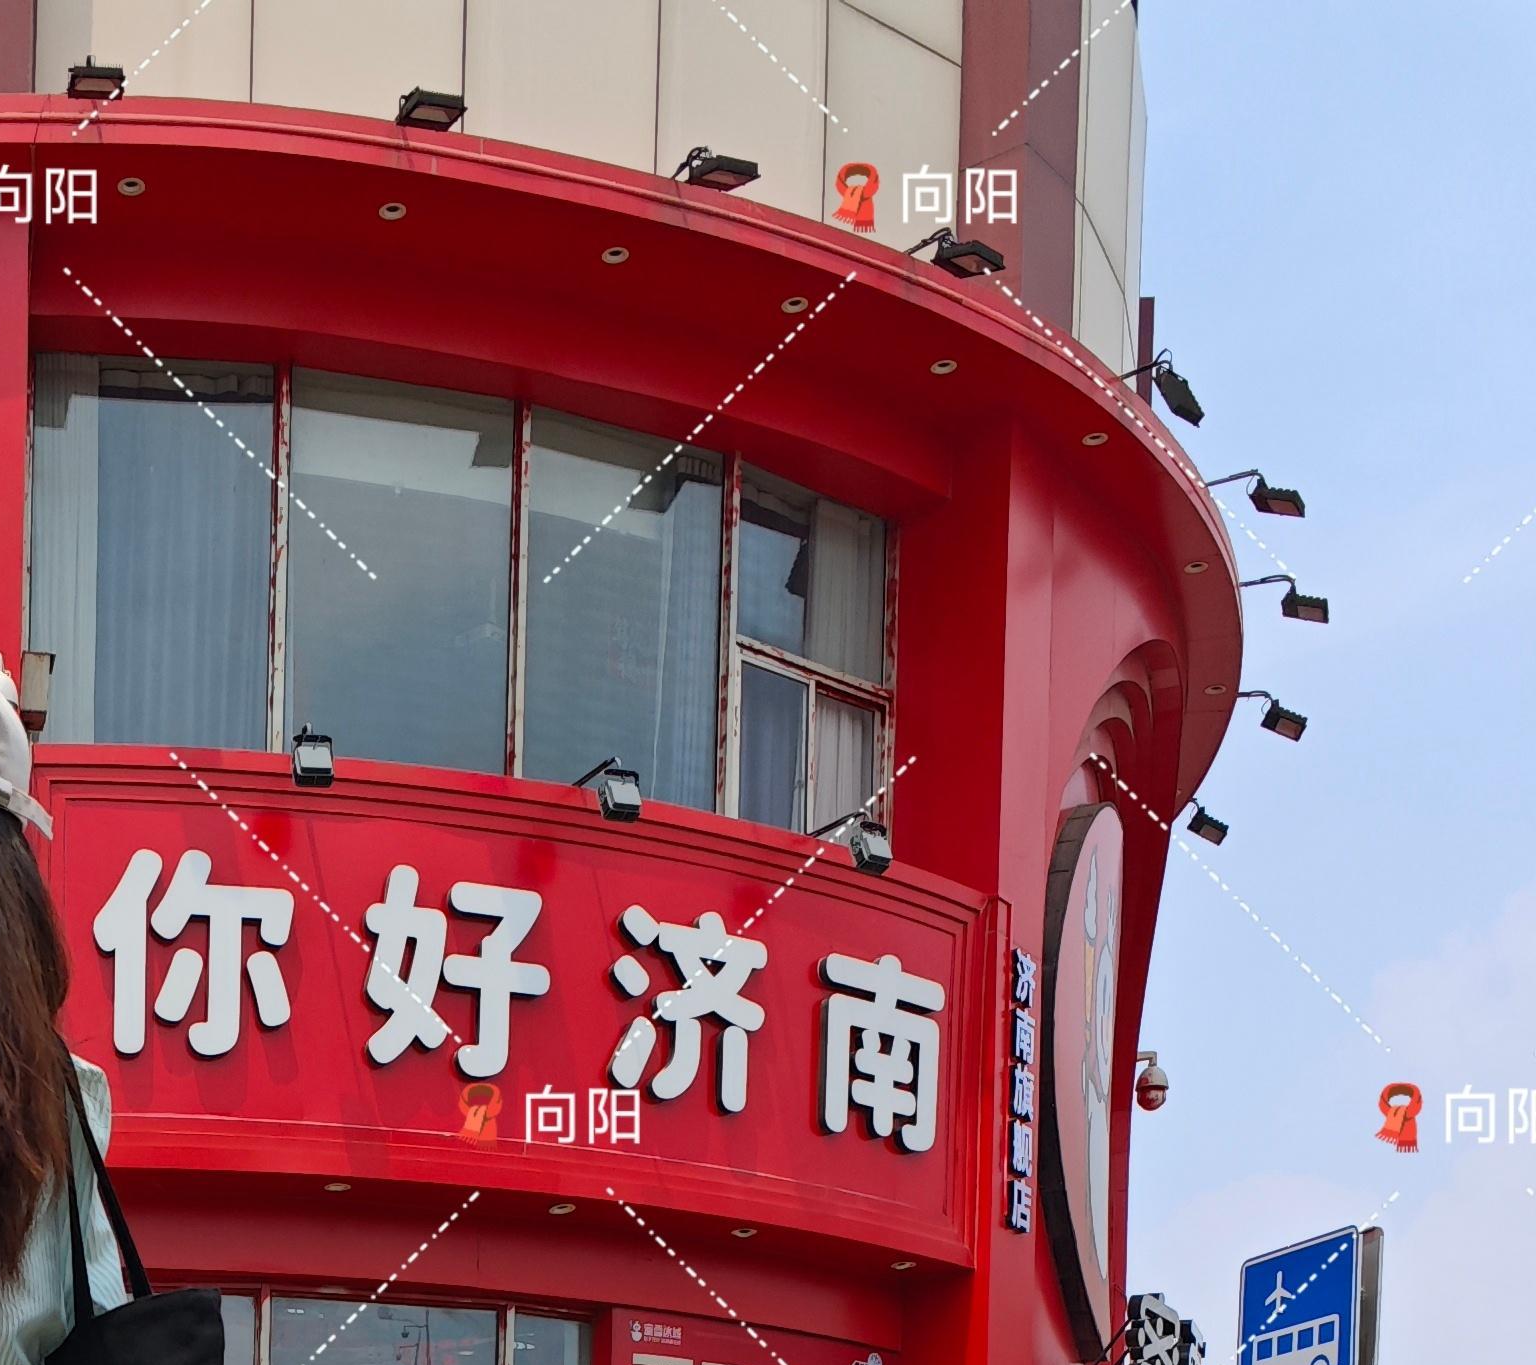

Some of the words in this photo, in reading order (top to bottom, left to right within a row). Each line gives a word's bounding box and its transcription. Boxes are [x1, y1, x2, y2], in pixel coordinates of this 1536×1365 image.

[93, 848, 946, 1153] 你好济南
[1012, 948, 1037, 1233] 济南旗舰店
